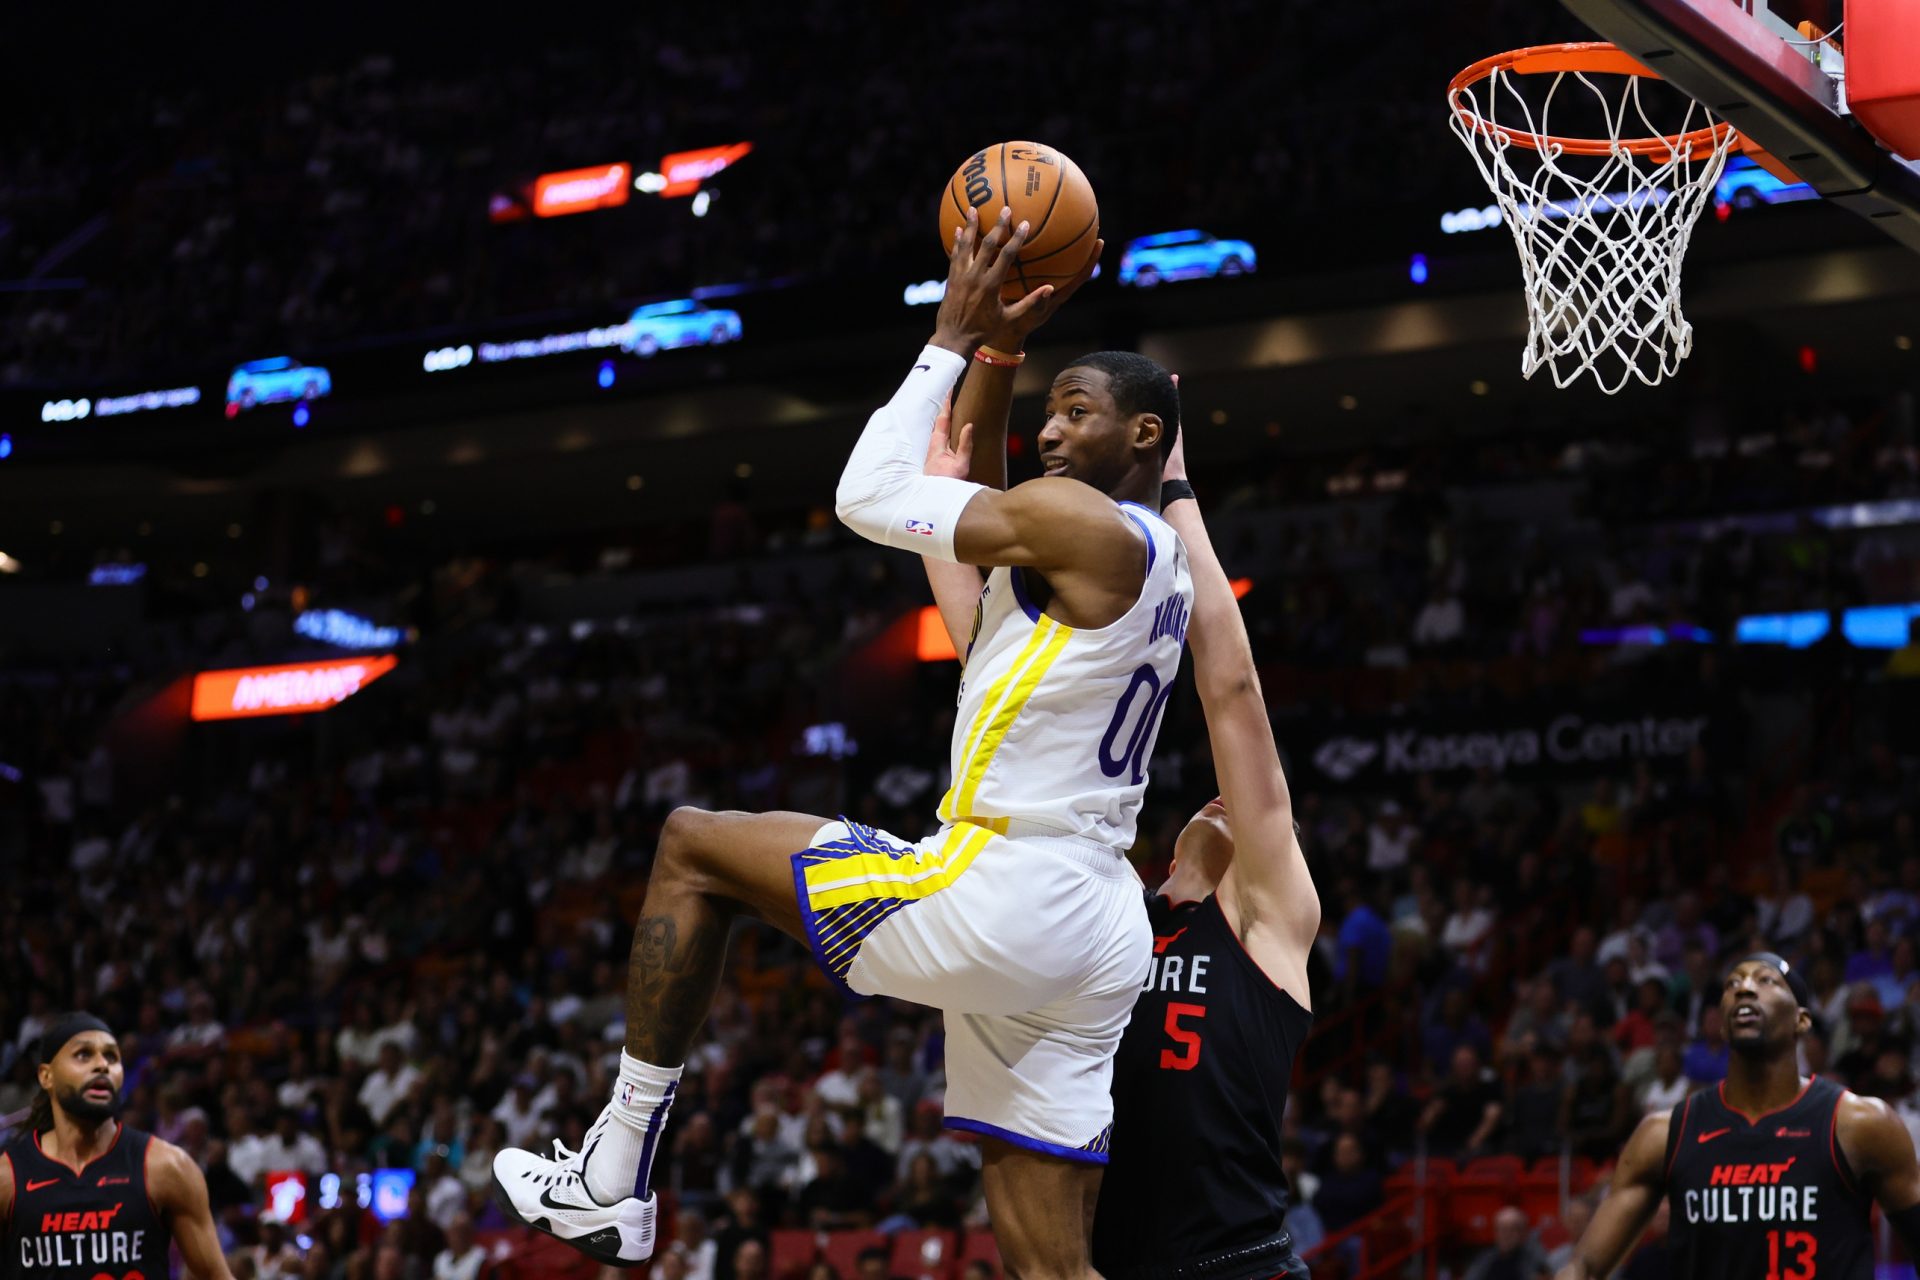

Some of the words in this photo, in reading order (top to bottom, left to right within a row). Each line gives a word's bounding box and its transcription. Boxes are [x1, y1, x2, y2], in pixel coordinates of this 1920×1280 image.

[1383, 727, 1540, 774] Kaseya
[1545, 712, 1710, 764] Center
[1160, 1001, 1206, 1071] 5
[1710, 1156, 1796, 1186] HEAT
[41, 1202, 123, 1232] HEAT
[1685, 1185, 1819, 1224] CULTURE
[21, 1230, 145, 1268] CULTURE
[1766, 1230, 1817, 1280] 13
